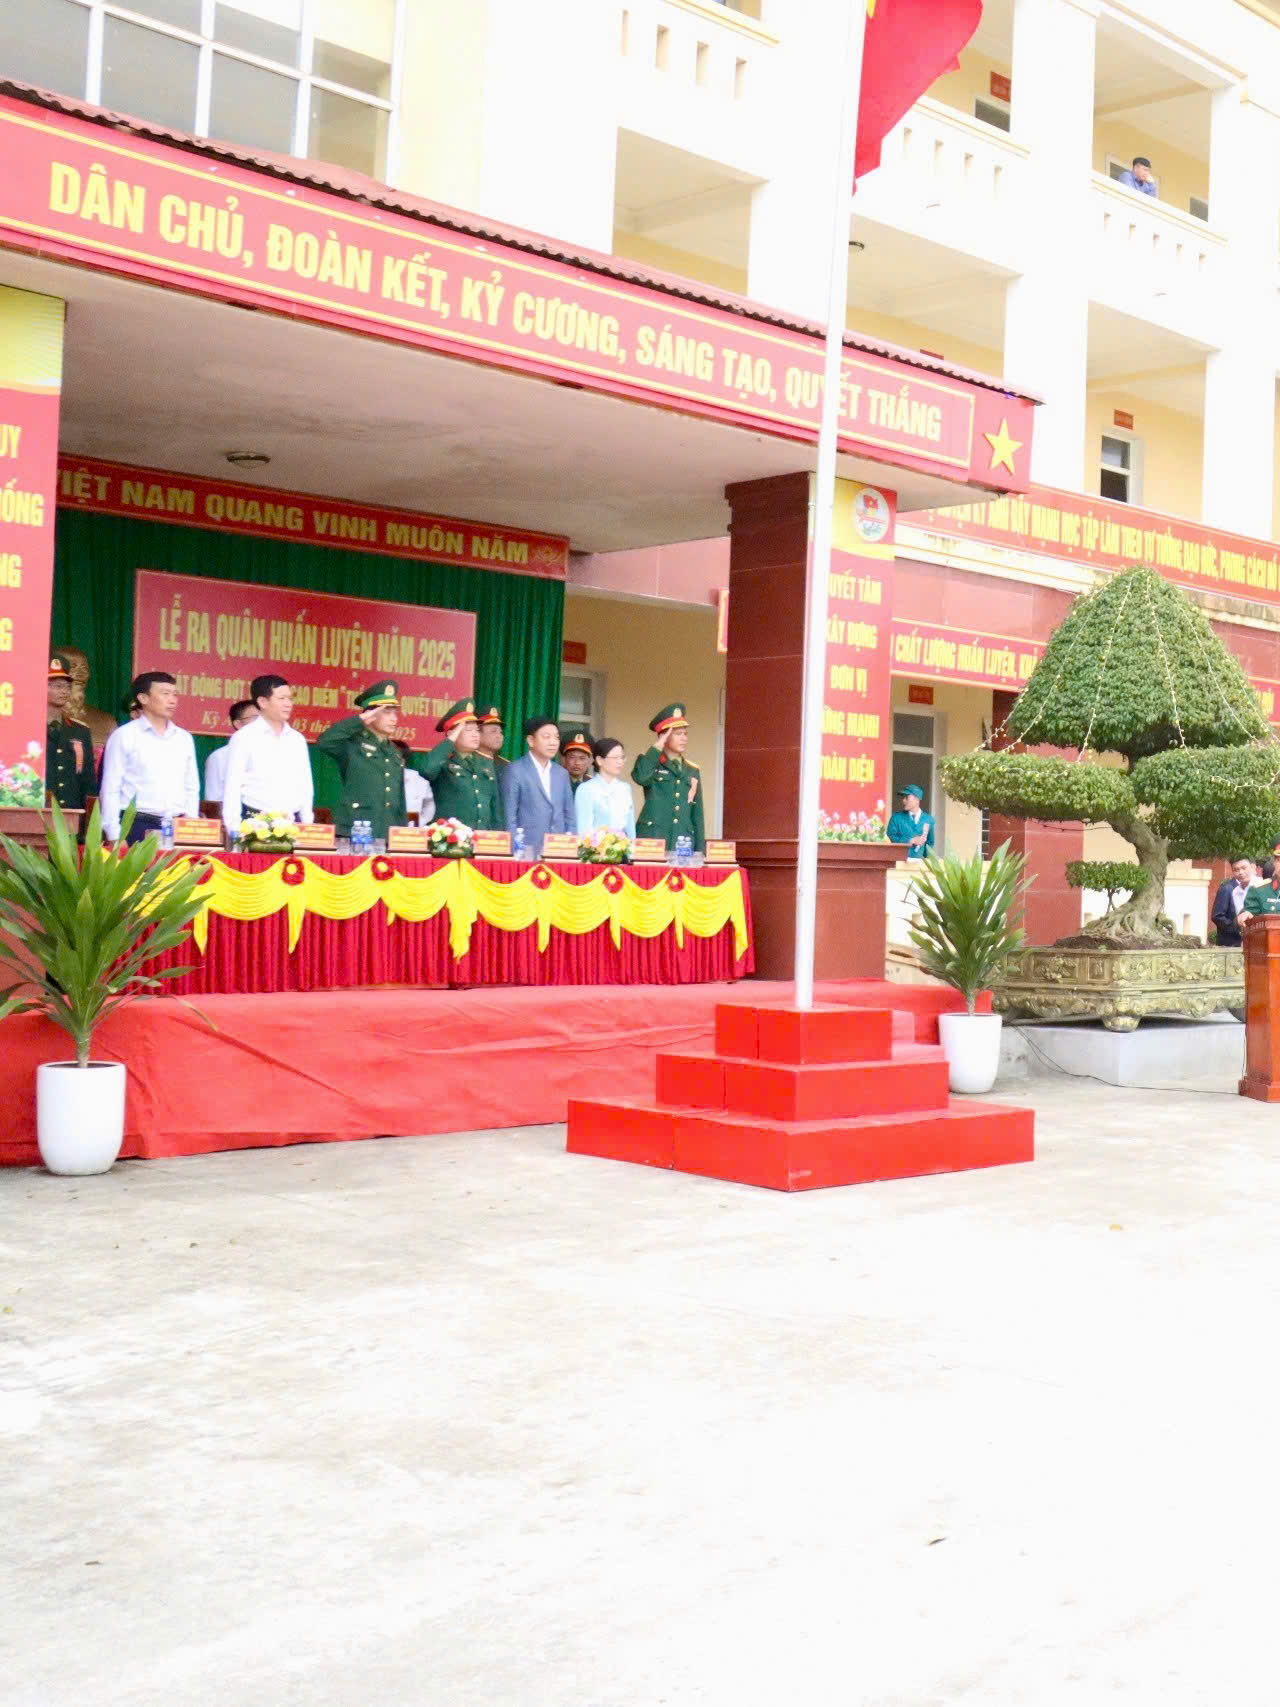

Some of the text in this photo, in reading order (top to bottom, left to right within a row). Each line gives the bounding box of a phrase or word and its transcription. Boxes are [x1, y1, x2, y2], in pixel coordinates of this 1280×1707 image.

[49, 161, 146, 234] DÂN
[159, 195, 254, 269] CHỦ,
[266, 223, 373, 294] ĐOÀN
[381, 252, 450, 319] KẾT,
[460, 271, 505, 326] KỶ
[513, 291, 627, 364] CƯƠNG,
[636, 324, 715, 383] SÁNG
[721, 346, 777, 402] TẠO,
[869, 384, 942, 442] THẮNG
[57, 467, 529, 564] IỆT NAM QUANG VINH MUÔN NĂM
[160, 593, 457, 680] LỄ RA QUÂN HUẤN LUYỆN NĂM 2025
